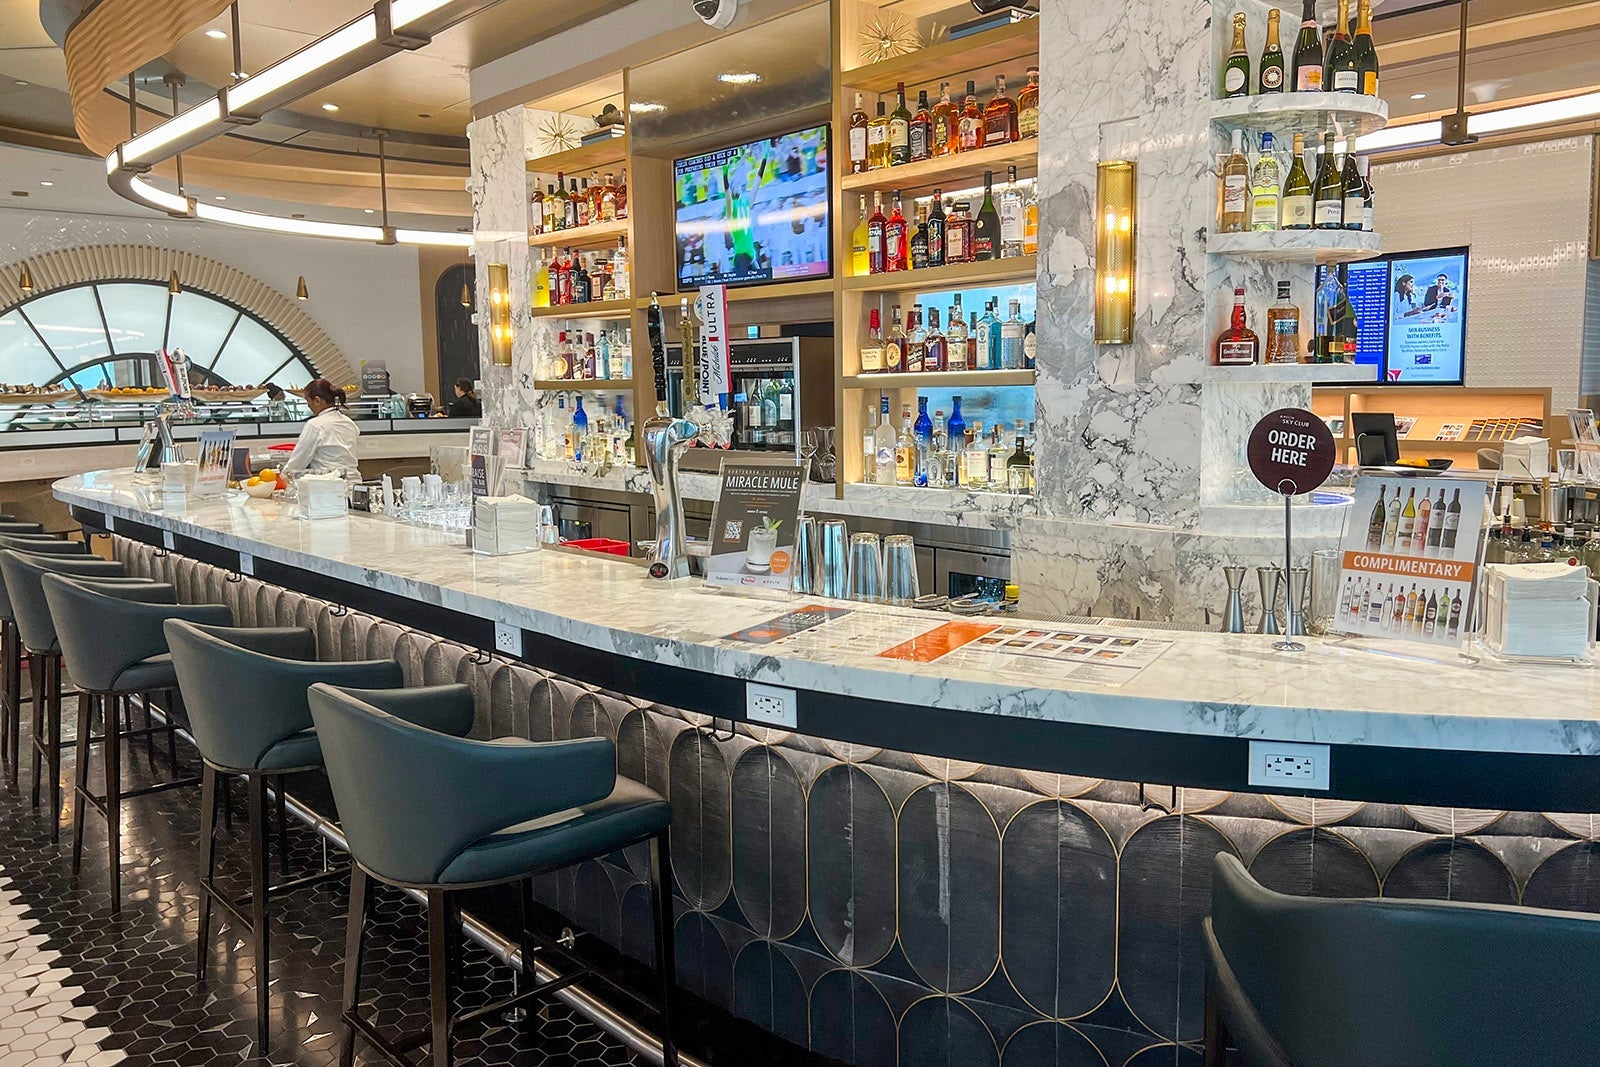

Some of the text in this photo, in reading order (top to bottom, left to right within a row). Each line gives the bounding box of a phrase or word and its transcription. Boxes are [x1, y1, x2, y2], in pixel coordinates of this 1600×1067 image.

[706, 292, 718, 334] ULTRA
[1268, 429, 1316, 450] ORDER
[1271, 447, 1308, 467] HERE
[725, 475, 799, 490] MIRACLE MULE
[1353, 555, 1463, 577] COMPLIMENTARY
